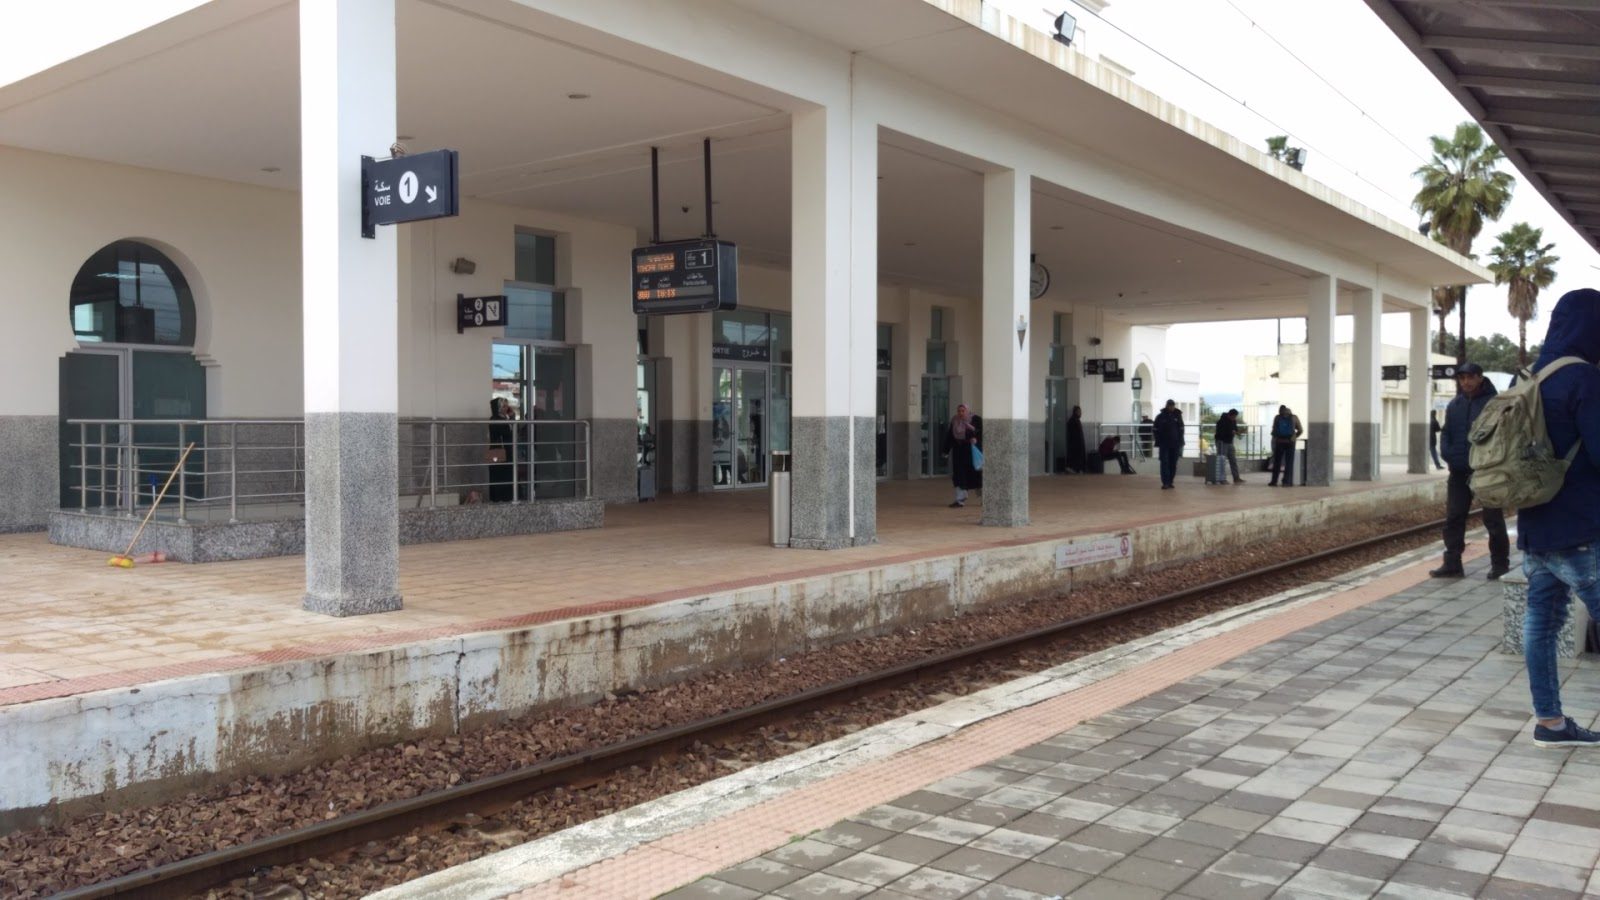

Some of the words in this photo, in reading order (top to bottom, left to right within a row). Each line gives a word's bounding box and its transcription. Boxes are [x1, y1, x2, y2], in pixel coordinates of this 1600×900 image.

[374, 180, 391, 192] سكة
[374, 195, 391, 206] VOIE
[701, 251, 707, 265] 1
[712, 347, 730, 355] ORTIE
